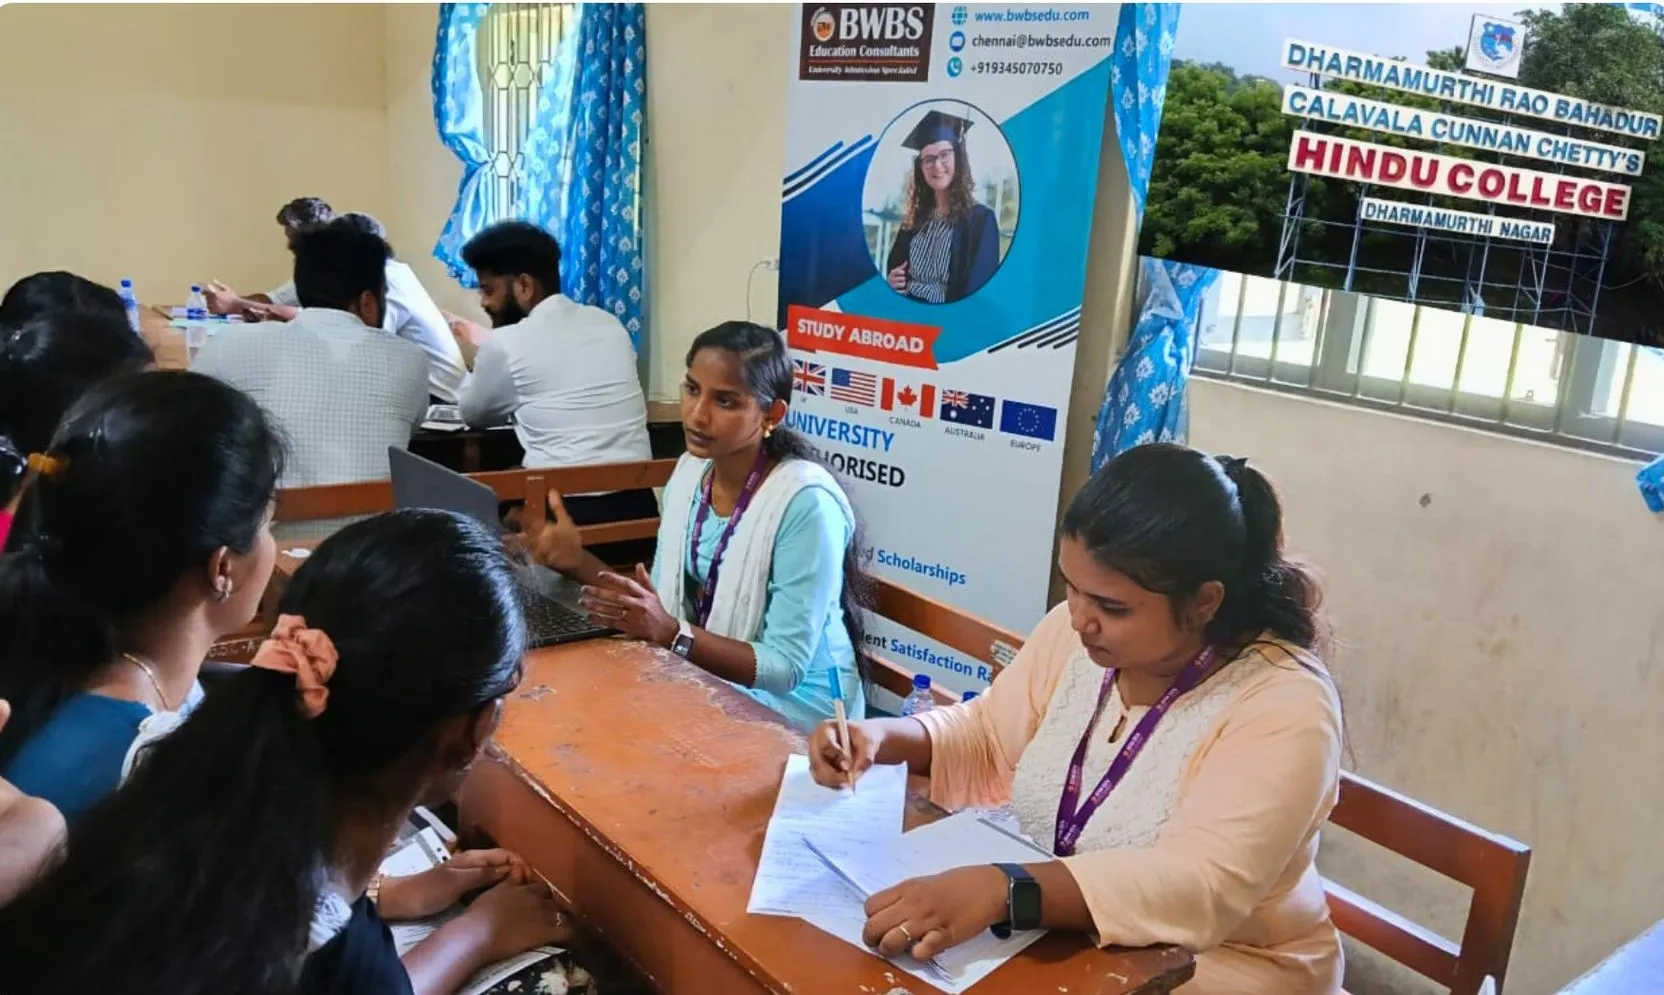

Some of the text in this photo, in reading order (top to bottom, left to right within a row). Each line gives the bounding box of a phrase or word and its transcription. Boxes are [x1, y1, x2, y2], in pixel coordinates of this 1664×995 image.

[839, 6, 924, 40] BWBS
[974, 8, 1090, 22] www.bwbsedu.com
[809, 44, 920, 57] Education Consultants
[971, 33, 1112, 48] chennai@bwbsedu.com
[970, 61, 1064, 75] +919345070750
[1288, 43, 1494, 105] DHARMAMURTHI
[1500, 88, 1549, 115] RAO
[1554, 98, 1658, 137] BAHADUR
[1289, 91, 1640, 173] CALAVALA CUNNAN CHETTY'S
[1294, 136, 1627, 217] HINDU COLLEGE
[1364, 202, 1552, 243] DHARMAMURTHI NAGAR
[797, 318, 925, 354] STUDY ABROAD
[785, 409, 895, 453] UNIVERSITY
[888, 415, 922, 429] CANADA
[944, 426, 986, 442] AUSTRALIA
[1010, 439, 1042, 453] EUROPE
[877, 549, 967, 586] Scholarships
[890, 638, 973, 677] Satisfaction
